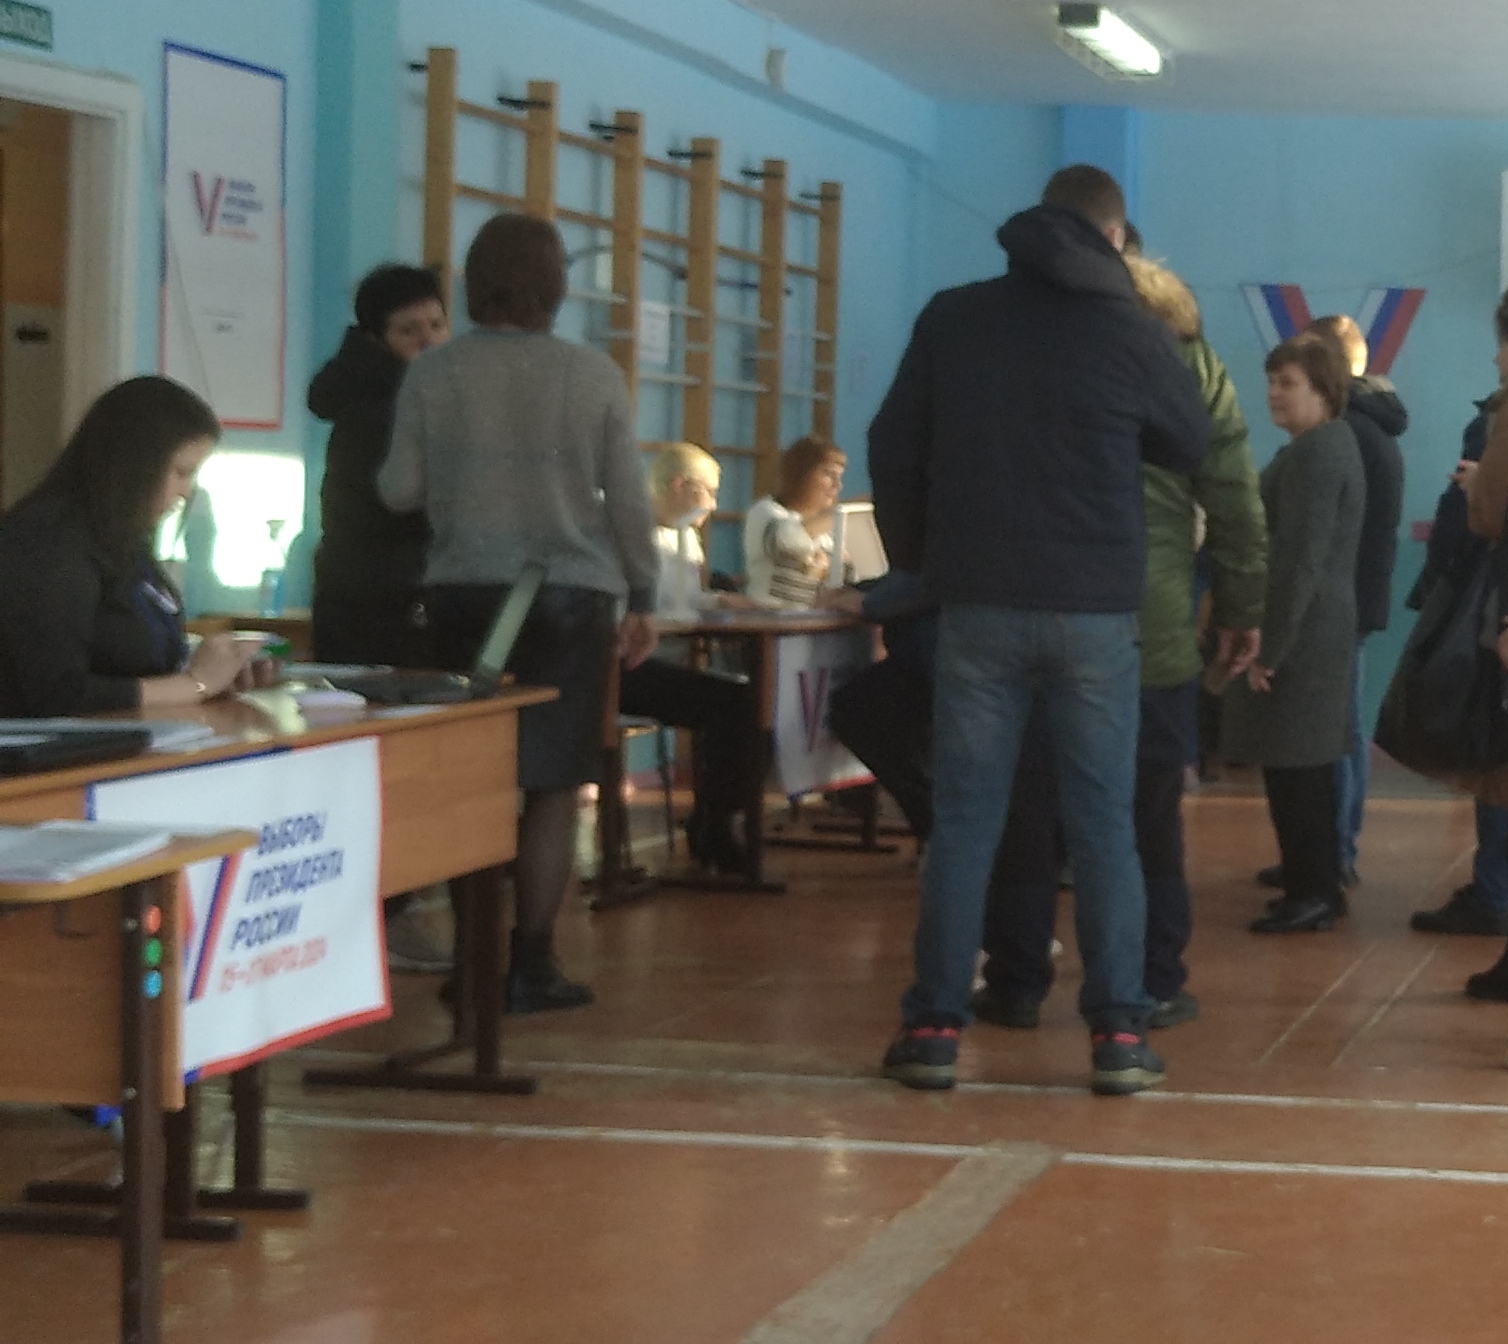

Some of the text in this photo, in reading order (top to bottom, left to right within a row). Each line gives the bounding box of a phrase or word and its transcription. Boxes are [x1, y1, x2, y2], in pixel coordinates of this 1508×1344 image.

[256, 811, 327, 857] ВЫБОРЫ
[245, 848, 344, 903] ПРЕЗИДЕНТА
[229, 905, 302, 950] РОССИИ
